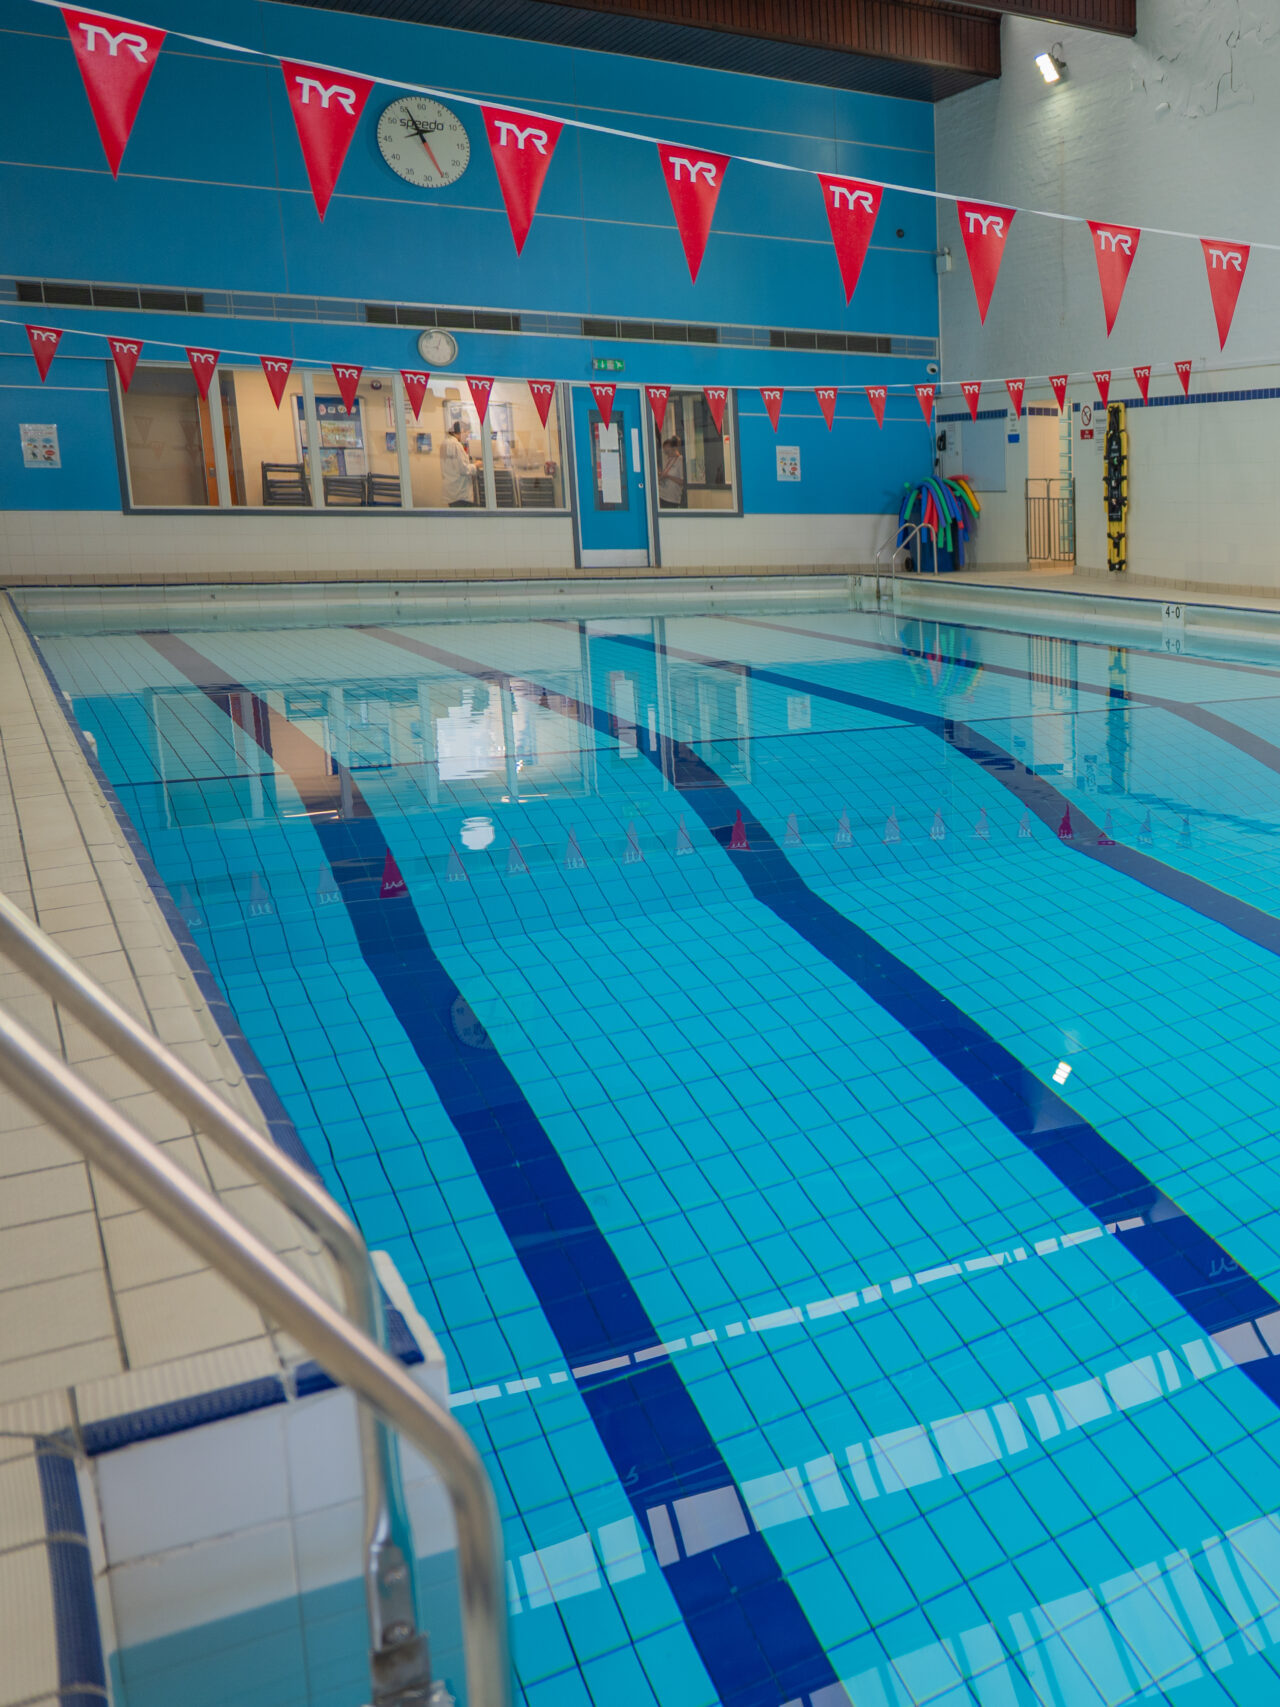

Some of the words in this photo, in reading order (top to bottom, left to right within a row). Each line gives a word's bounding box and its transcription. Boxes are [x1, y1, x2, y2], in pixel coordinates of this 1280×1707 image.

[79, 23, 147, 63] TYR
[296, 76, 356, 114] TYR
[388, 117, 398, 125] 50
[400, 118, 444, 131] speedo
[448, 124, 458, 132] 10
[494, 120, 547, 154] TYR
[456, 143, 466, 151] 15
[406, 168, 415, 176] 35
[669, 157, 716, 186] TYR
[830, 186, 873, 213] TYR
[966, 212, 1003, 238] TYR
[1097, 230, 1131, 255] TYR
[1209, 249, 1241, 271] TYR
[32, 330, 56, 342] TYR
[114, 342, 137, 354] TYR
[191, 352, 214, 364] TYR
[265, 361, 287, 372] TYR
[337, 368, 358, 379] TYR
[405, 374, 425, 384] TYR
[470, 380, 490, 390] TYR
[532, 384, 551, 394] TYR
[964, 385, 978, 394] TYR
[594, 387, 612, 396] TYR
[649, 389, 666, 398] TYR
[708, 390, 724, 399] TYR
[764, 391, 780, 400] TYR
[818, 390, 834, 398] TYR
[869, 389, 884, 398] TYR
[918, 388, 932, 396] TYR
